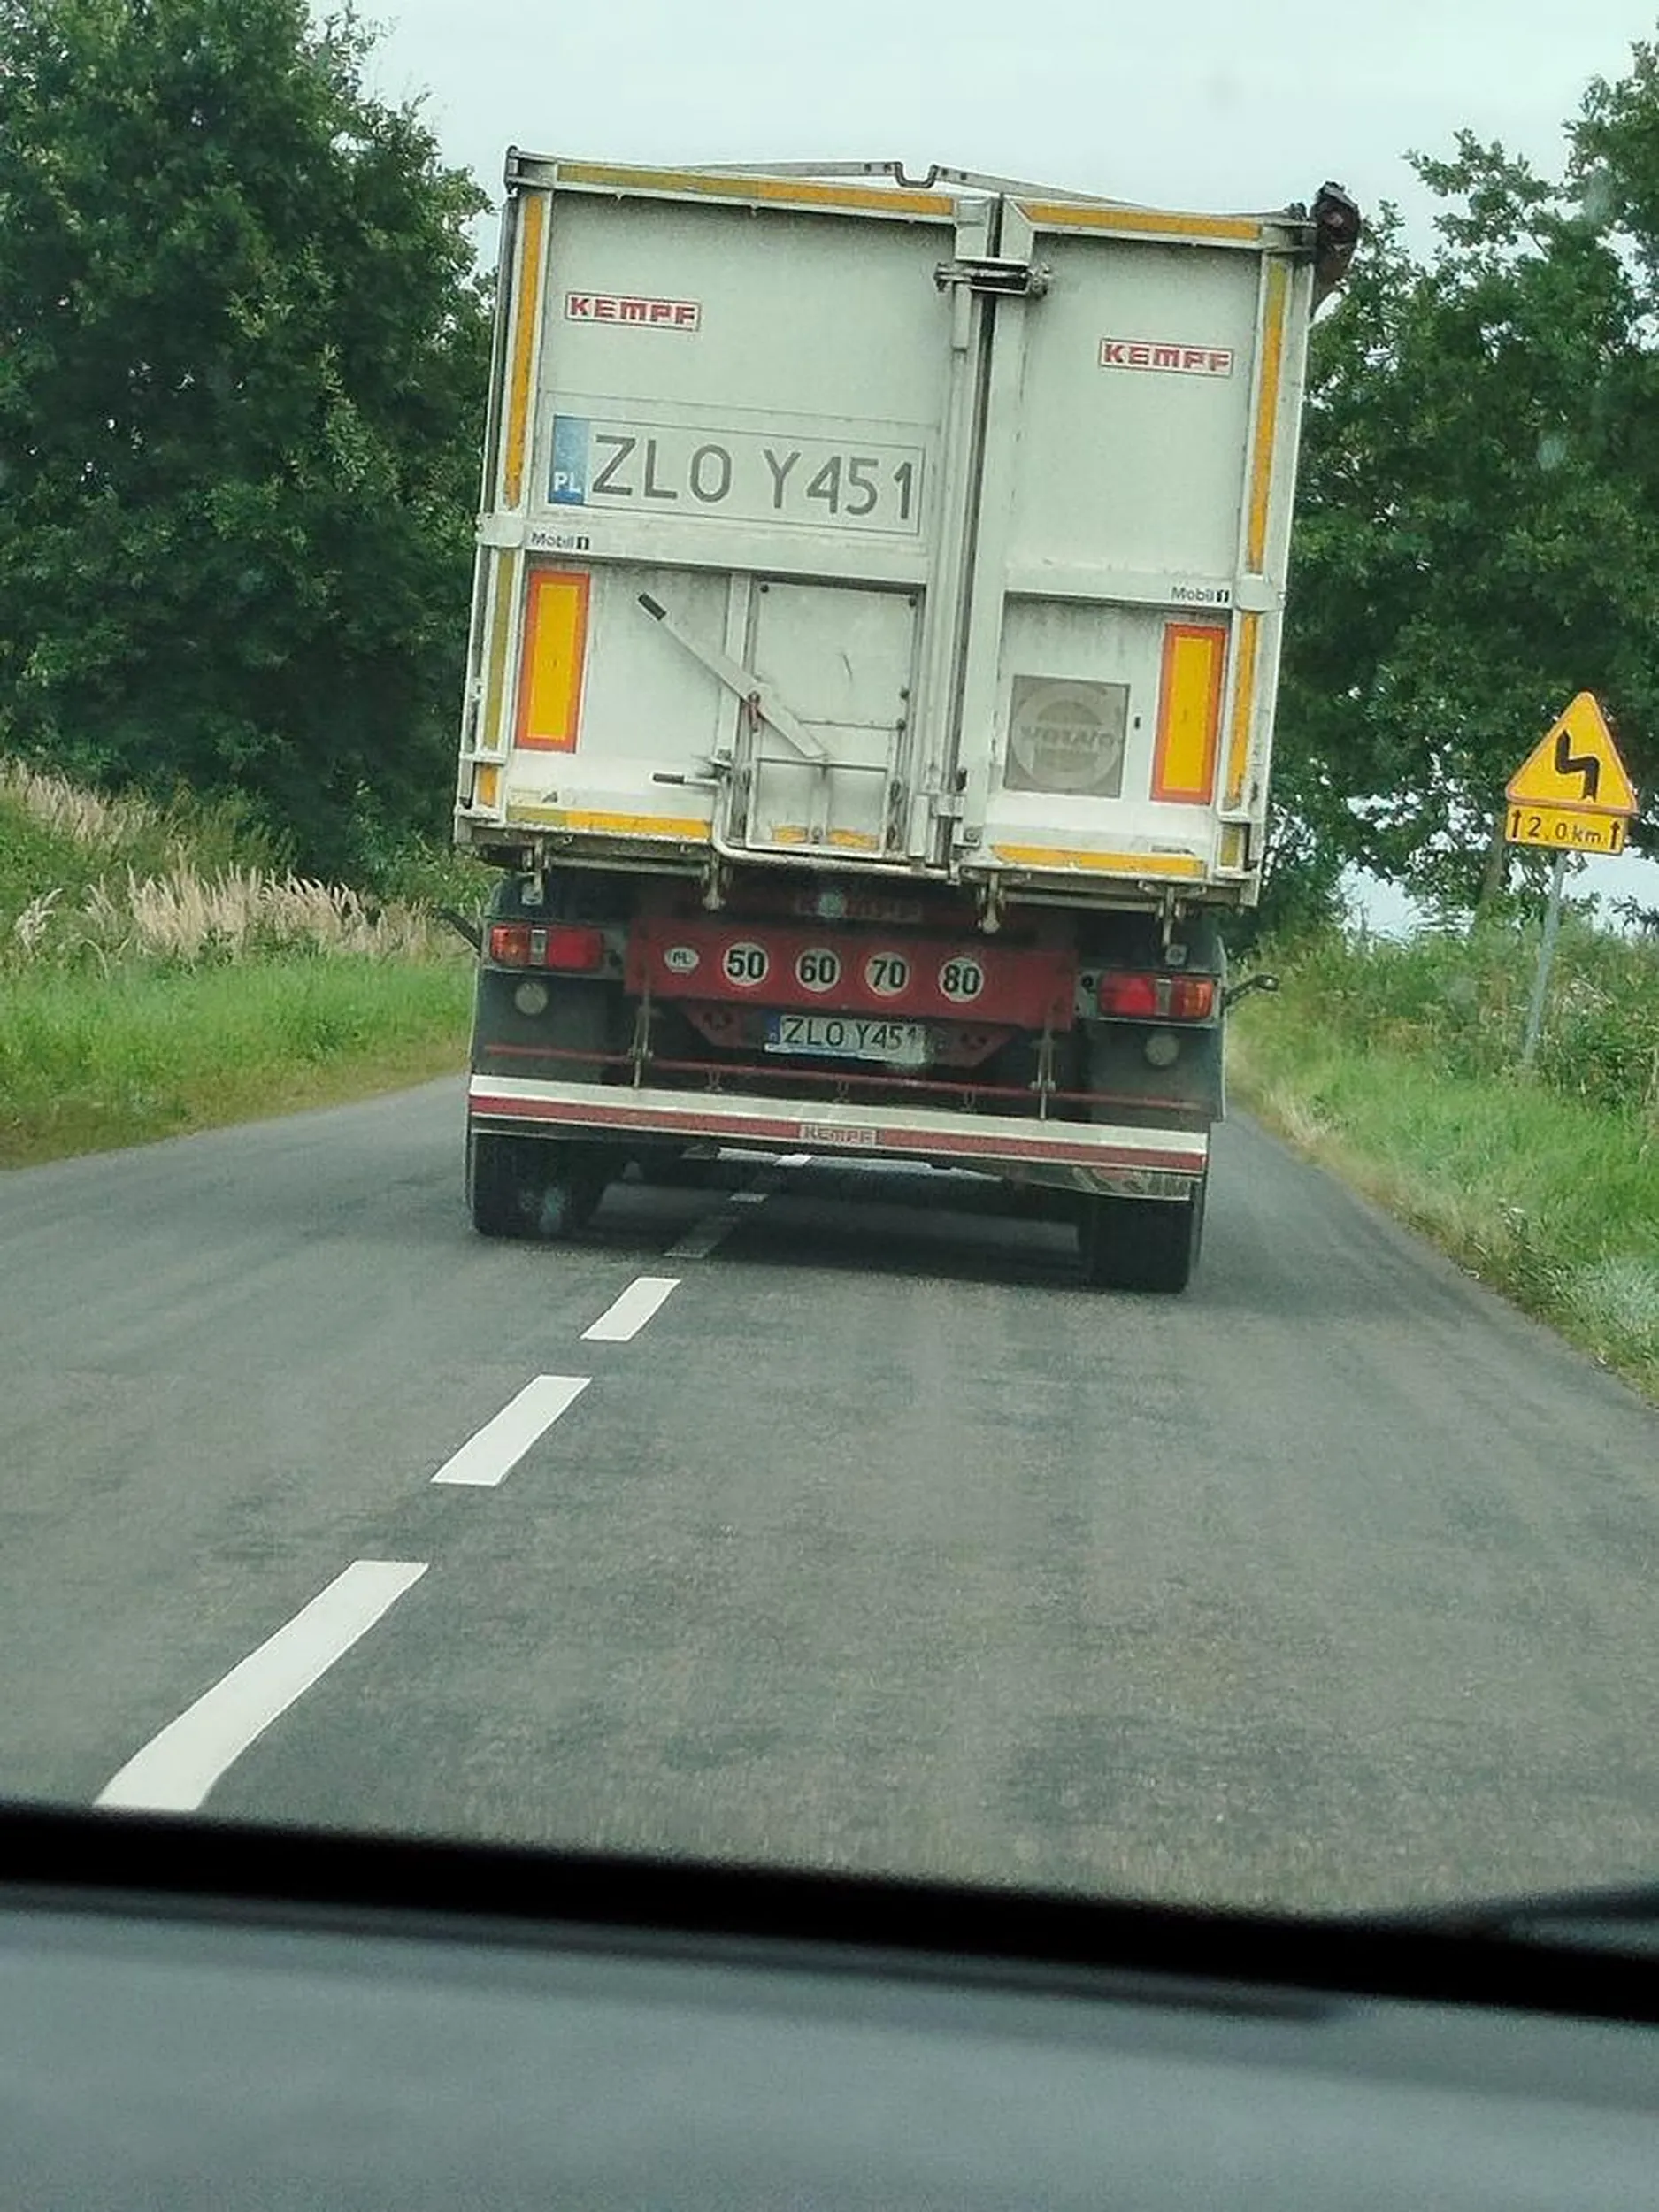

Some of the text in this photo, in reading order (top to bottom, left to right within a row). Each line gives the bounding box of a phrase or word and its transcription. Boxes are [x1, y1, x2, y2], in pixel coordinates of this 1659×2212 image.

[570, 296, 695, 325] KEMPF
[1104, 343, 1230, 372] KEMPF
[554, 472, 581, 492] PL
[592, 433, 913, 520] ZLO Y451
[532, 532, 574, 548] Mobil
[1171, 586, 1214, 602] Mobil
[1573, 825, 1601, 844] km
[726, 949, 979, 995] 50 60 70 80
[784, 1018, 844, 1047] ZLO
